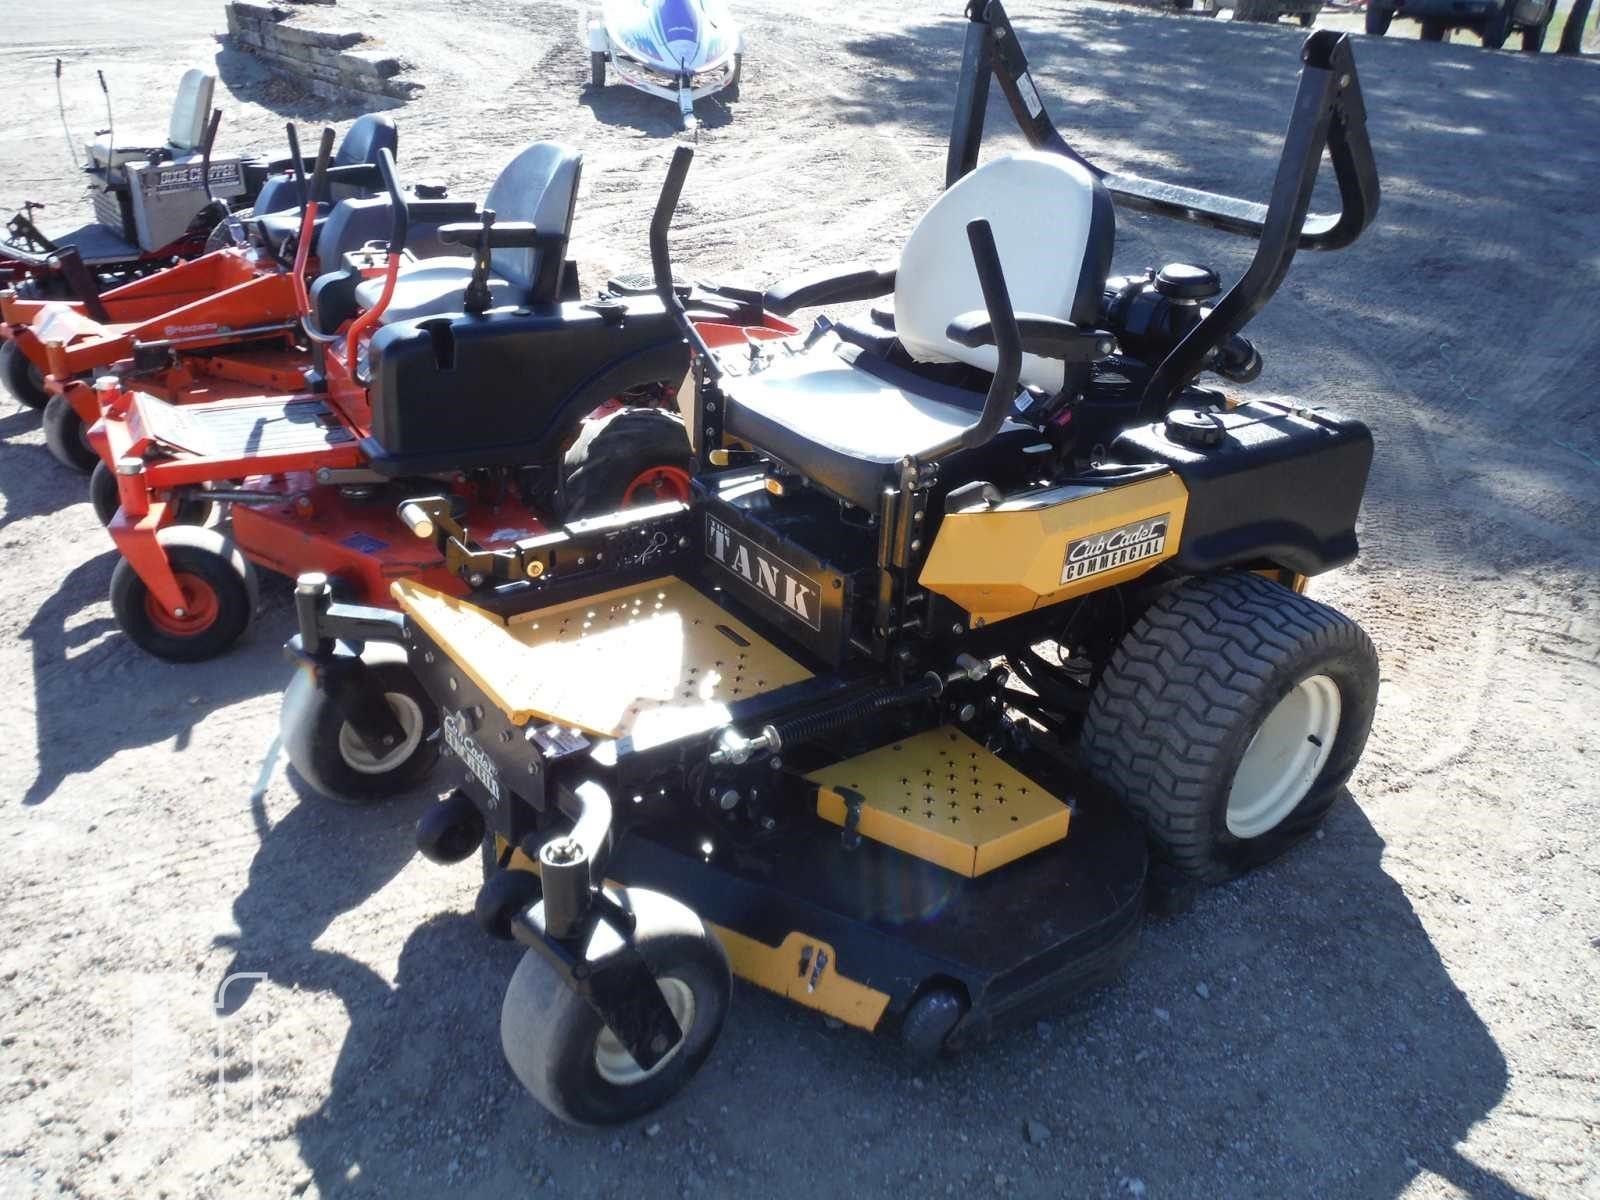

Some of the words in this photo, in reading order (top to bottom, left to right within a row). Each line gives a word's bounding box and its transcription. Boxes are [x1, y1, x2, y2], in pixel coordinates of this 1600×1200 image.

[1066, 540, 1159, 580] COMMERCIAL
[1069, 537, 1105, 562] Cub
[1106, 520, 1165, 551] Cadet
[709, 526, 811, 620] TANK
